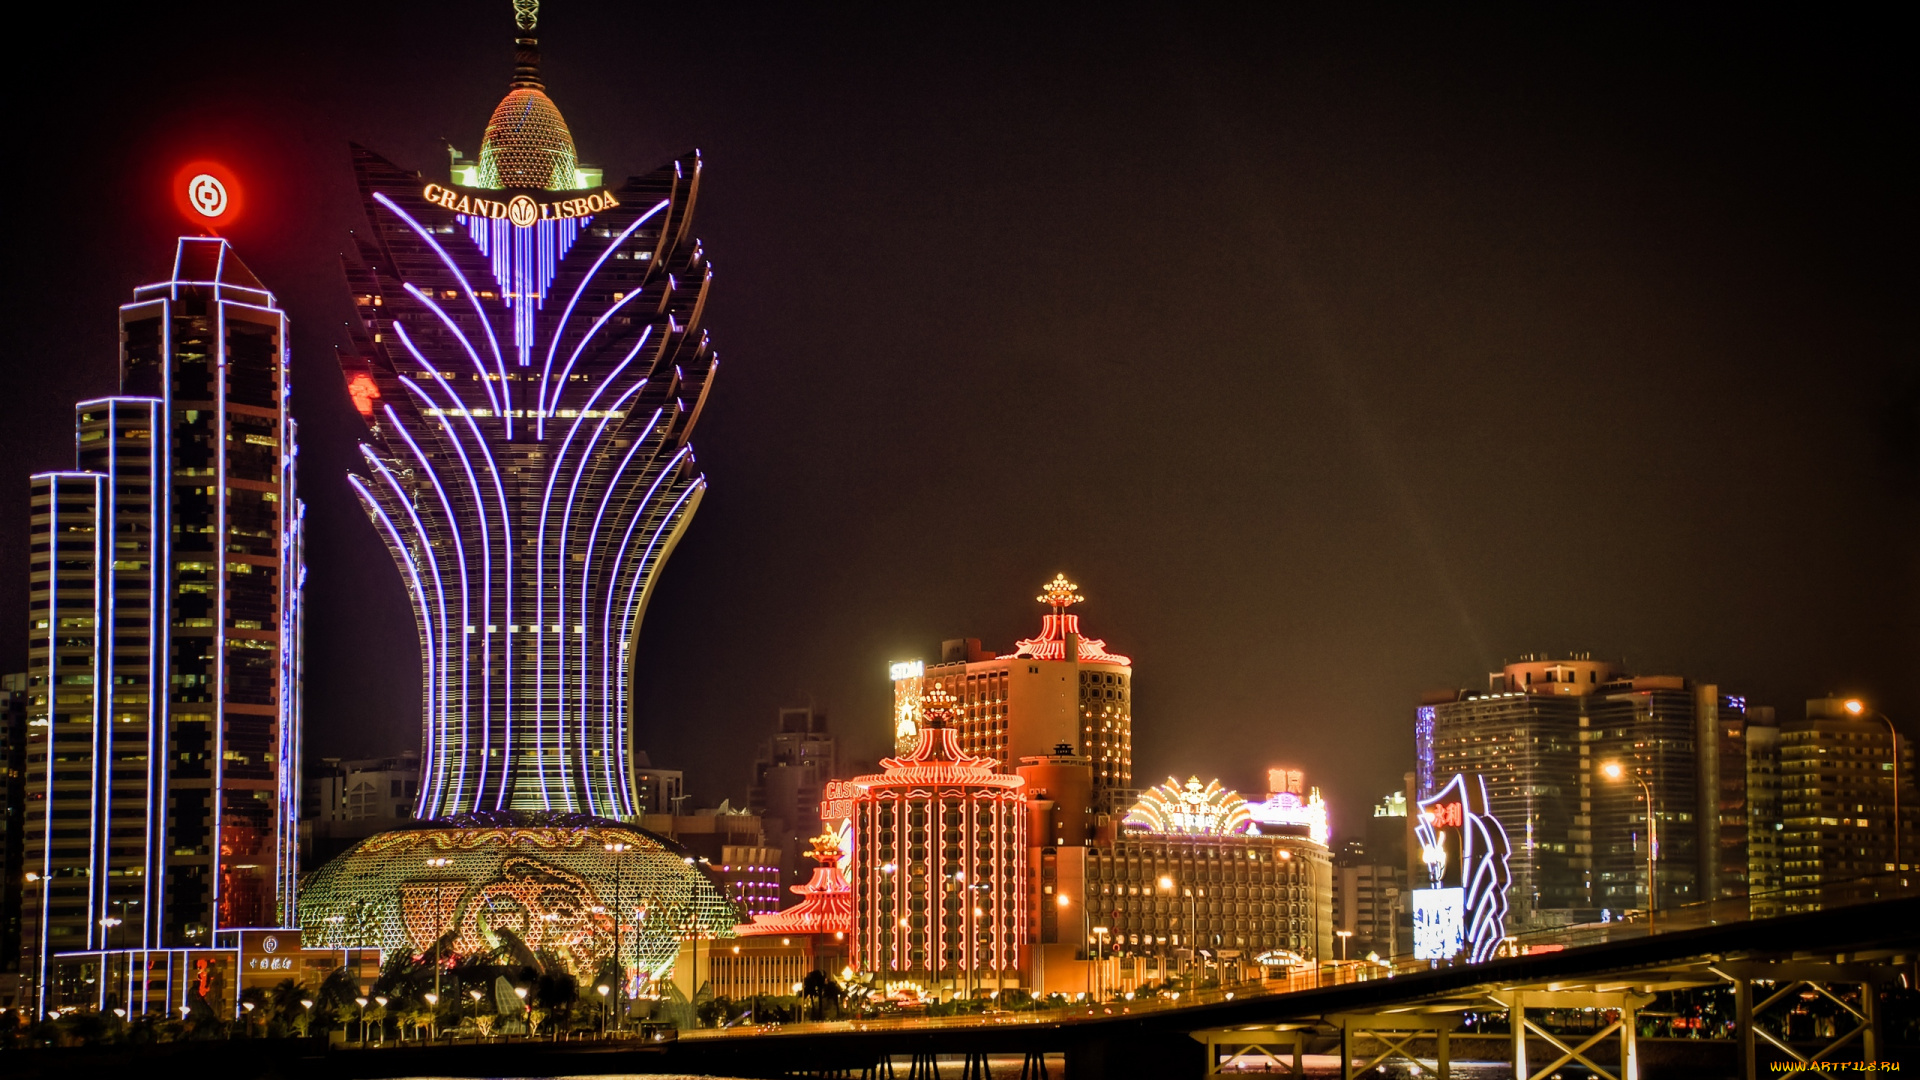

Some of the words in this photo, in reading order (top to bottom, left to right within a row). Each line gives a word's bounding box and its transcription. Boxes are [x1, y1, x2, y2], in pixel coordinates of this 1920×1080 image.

[423, 184, 508, 220] GRAND
[538, 190, 620, 221] LISBOA
[821, 799, 853, 820] LISB
[1160, 802, 1194, 814] HOTEL
[1195, 802, 1230, 814] LISBOA
